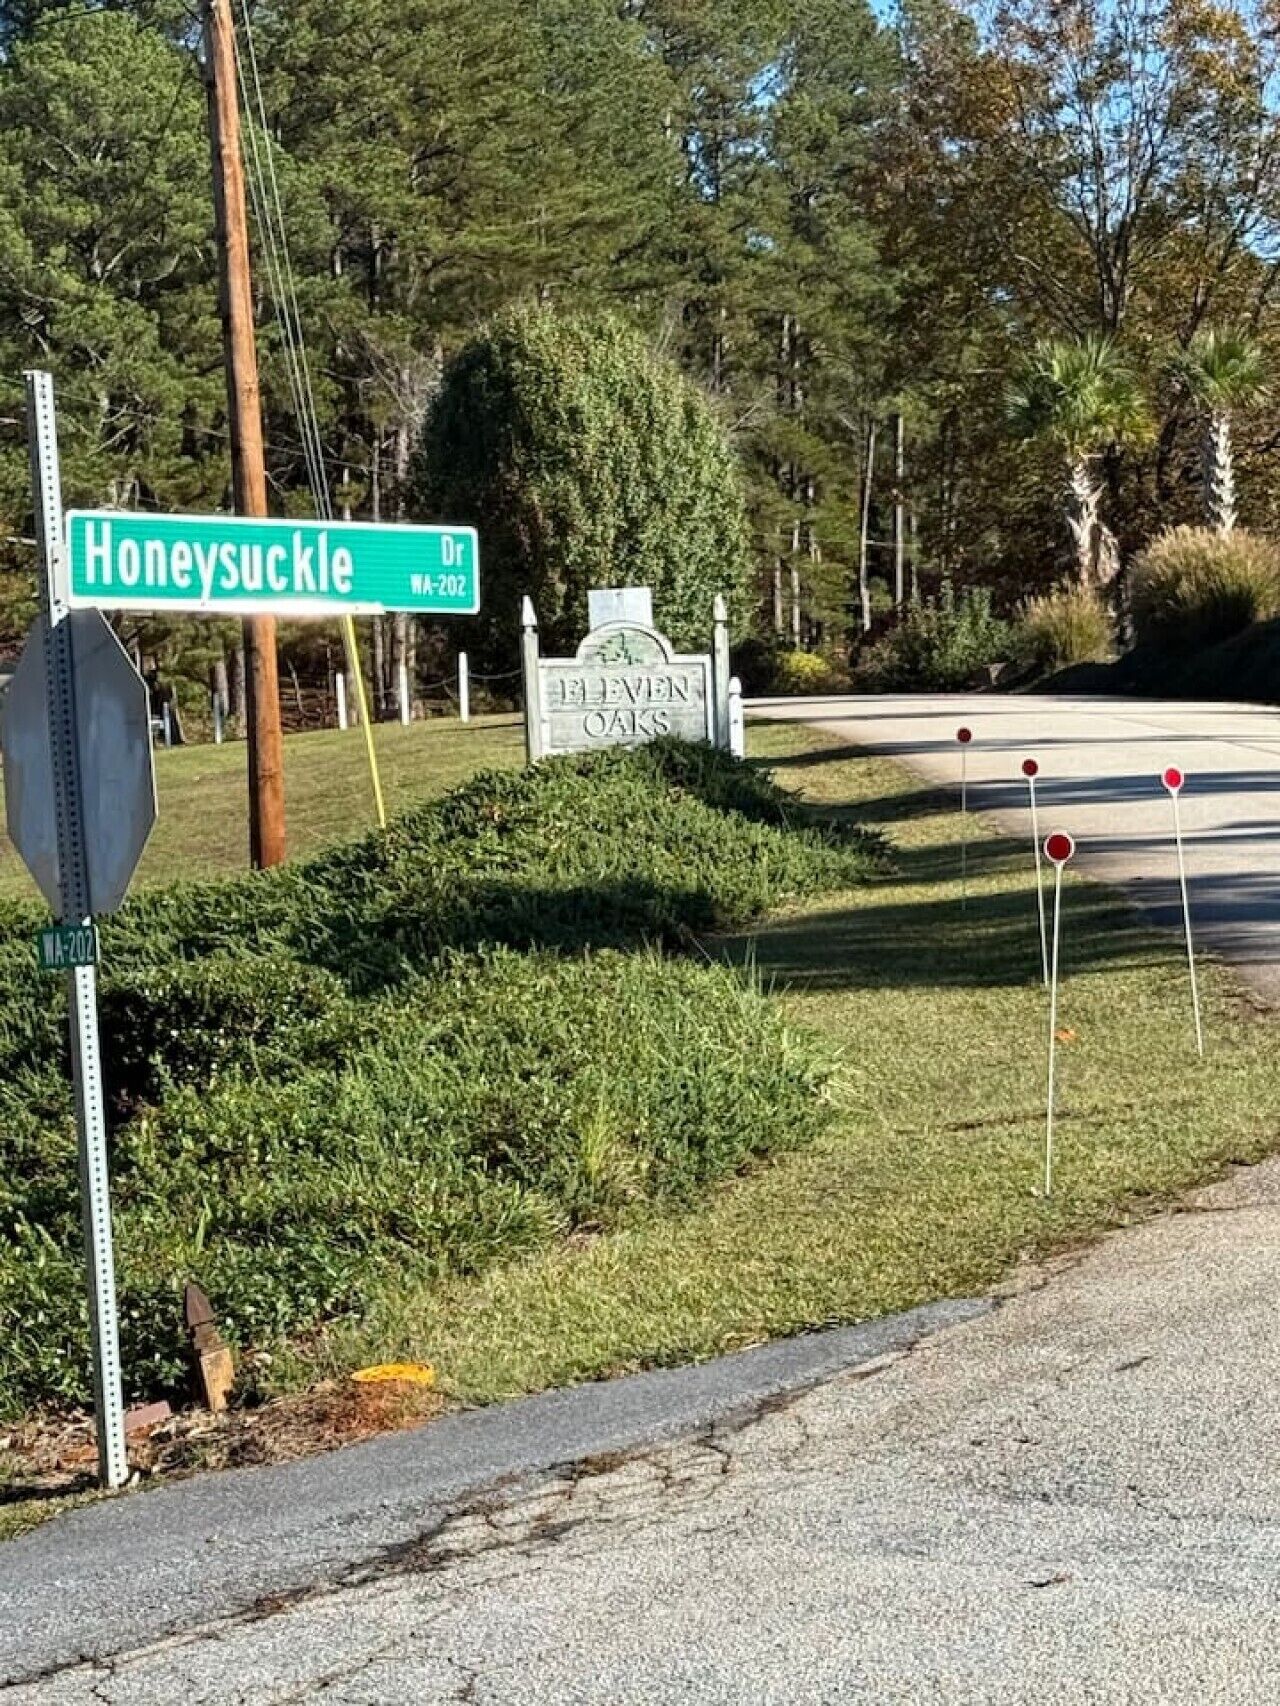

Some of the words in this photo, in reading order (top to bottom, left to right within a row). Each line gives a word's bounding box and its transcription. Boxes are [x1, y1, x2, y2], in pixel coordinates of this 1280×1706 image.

[84, 520, 354, 598] Honeysuckle
[440, 534, 465, 567] Dr
[410, 574, 467, 598] WA-202
[559, 676, 689, 705] ELEVEN
[583, 710, 670, 738] OAKS
[42, 930, 95, 964] WA-202
